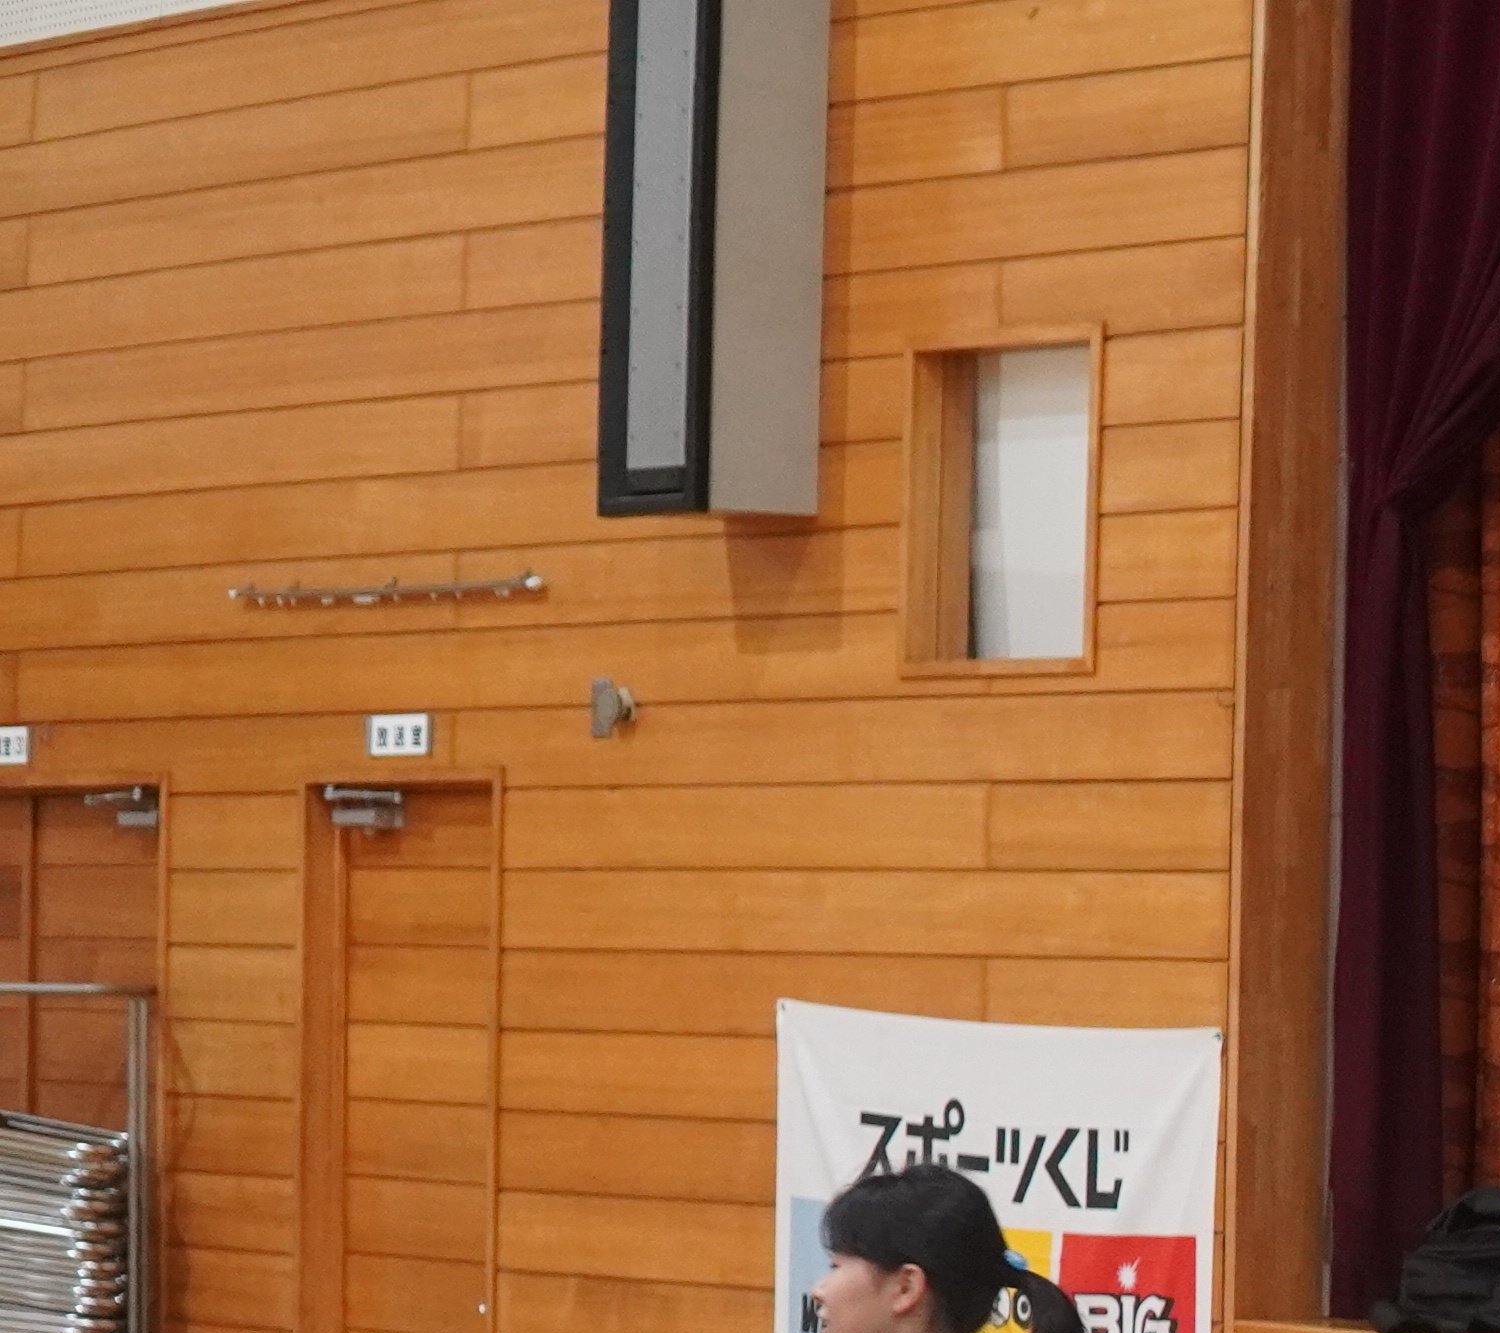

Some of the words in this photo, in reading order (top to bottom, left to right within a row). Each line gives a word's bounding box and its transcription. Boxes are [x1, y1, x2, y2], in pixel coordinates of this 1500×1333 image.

[860, 1097, 1129, 1208] スポーツくじ
